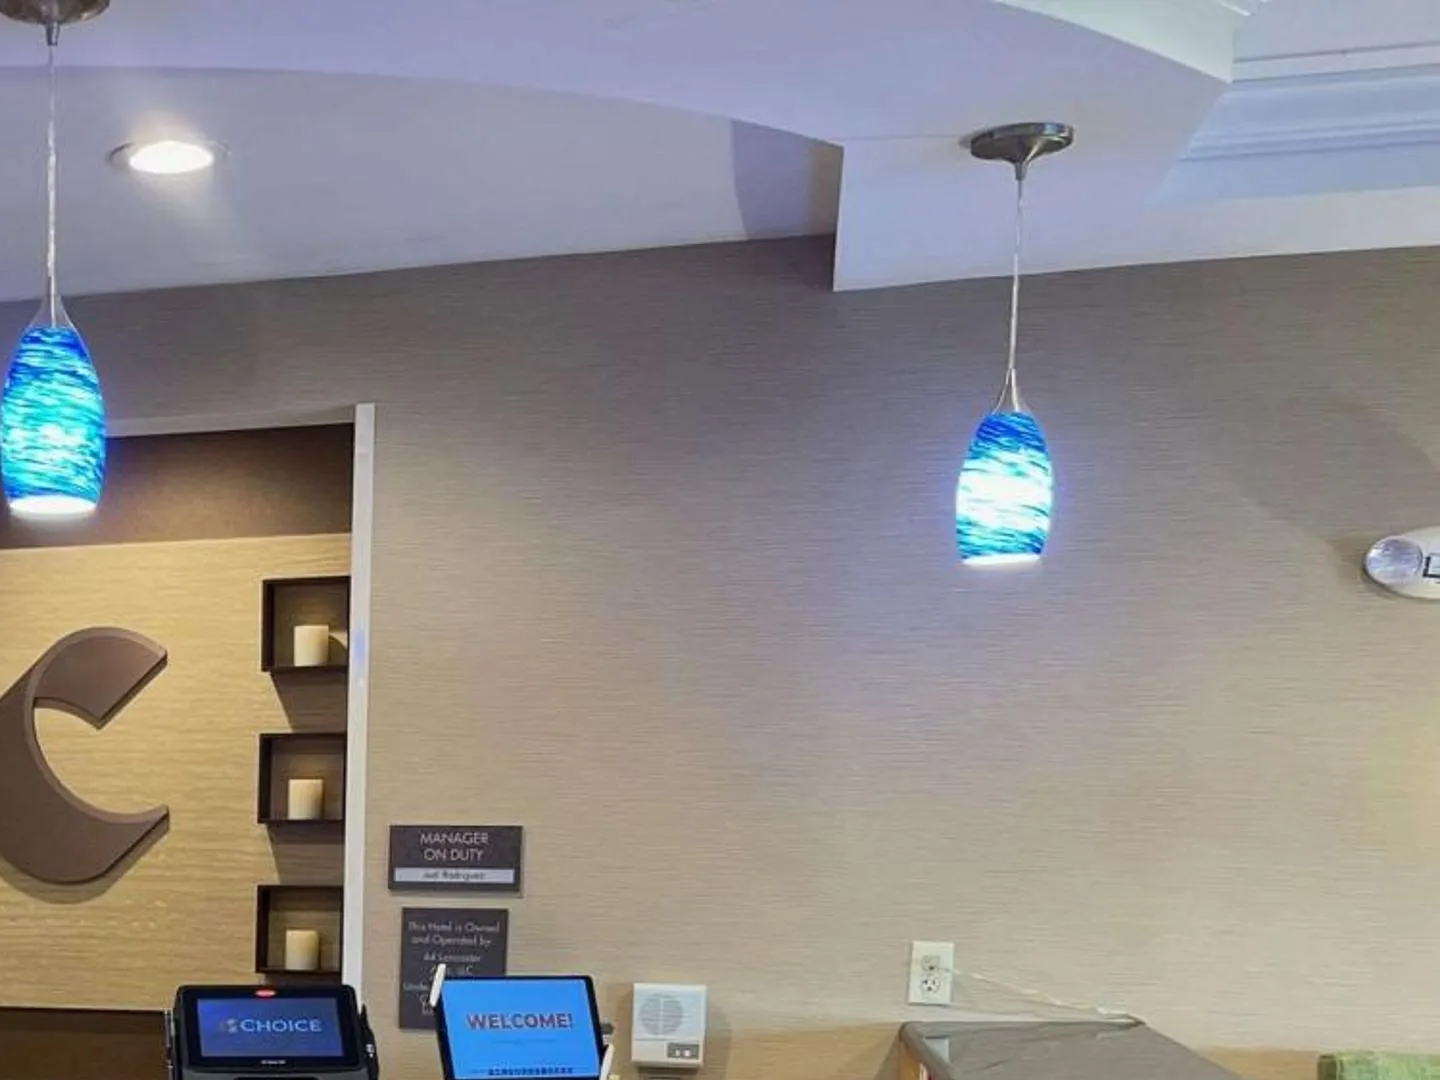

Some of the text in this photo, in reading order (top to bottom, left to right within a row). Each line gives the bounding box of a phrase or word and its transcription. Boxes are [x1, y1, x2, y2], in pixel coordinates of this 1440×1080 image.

[420, 832, 489, 845] MANAGER
[423, 847, 484, 861] ON DUTY
[464, 920, 500, 933] Owned
[411, 934, 492, 950] and Operated by
[240, 1018, 323, 1033] CHOICE
[467, 1013, 573, 1030] WELCOME!
